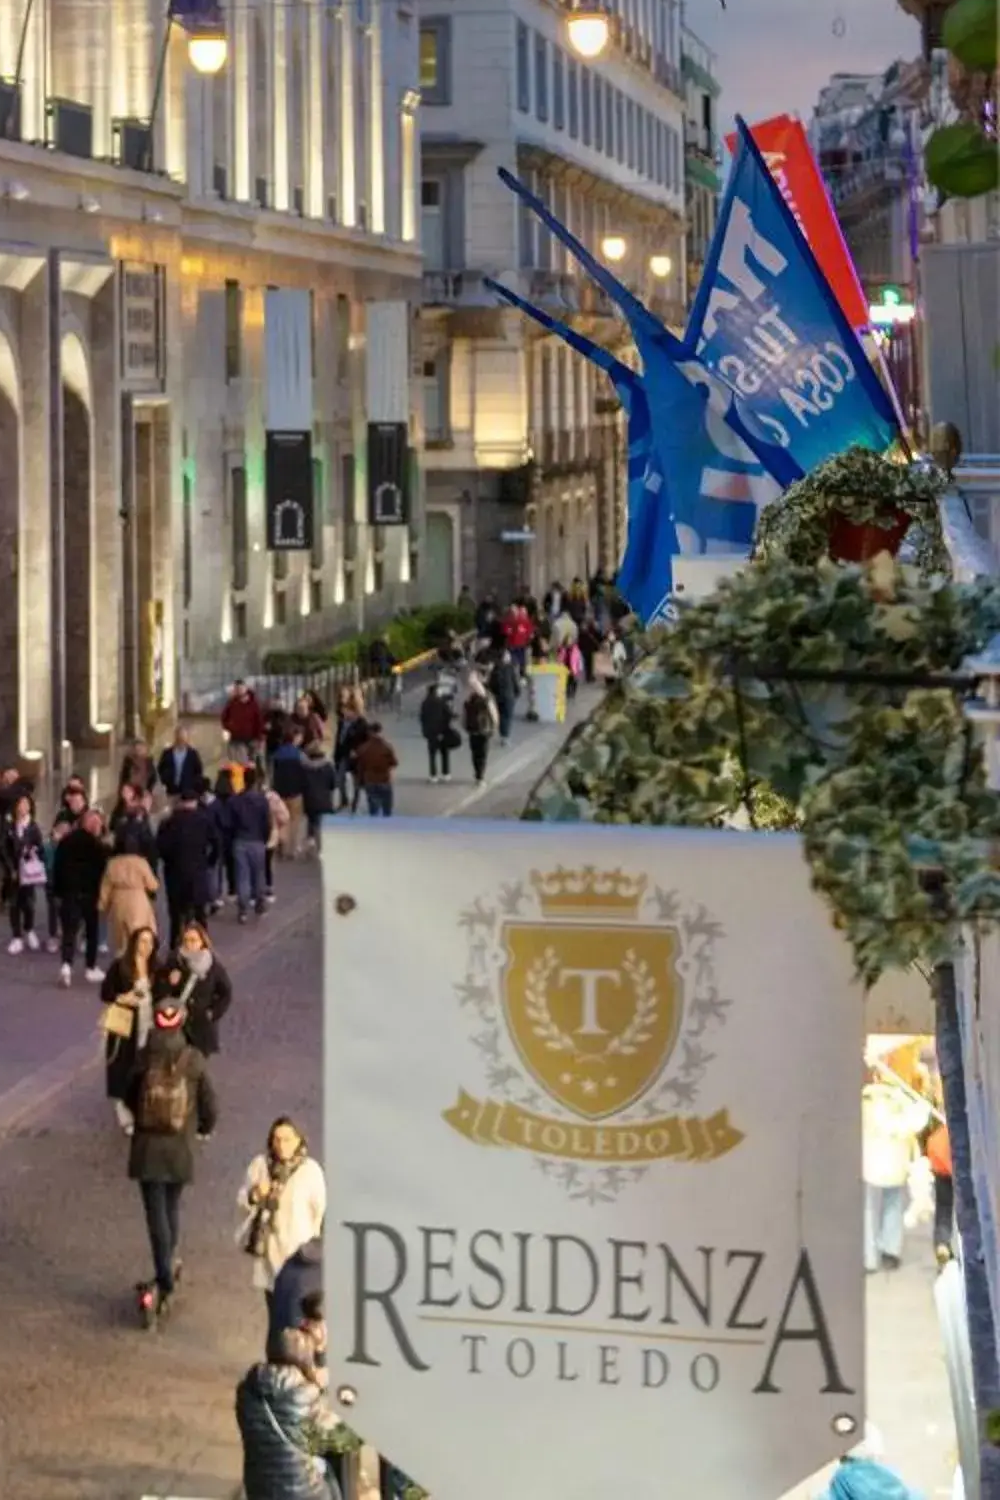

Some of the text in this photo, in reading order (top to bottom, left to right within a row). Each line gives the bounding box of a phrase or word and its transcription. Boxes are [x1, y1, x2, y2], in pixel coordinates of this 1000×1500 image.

[557, 968, 622, 1035] T
[516, 1114, 671, 1156] TOLEDO
[342, 1220, 856, 1395] RESIDENZA
[461, 1334, 721, 1393] TOLEDO
